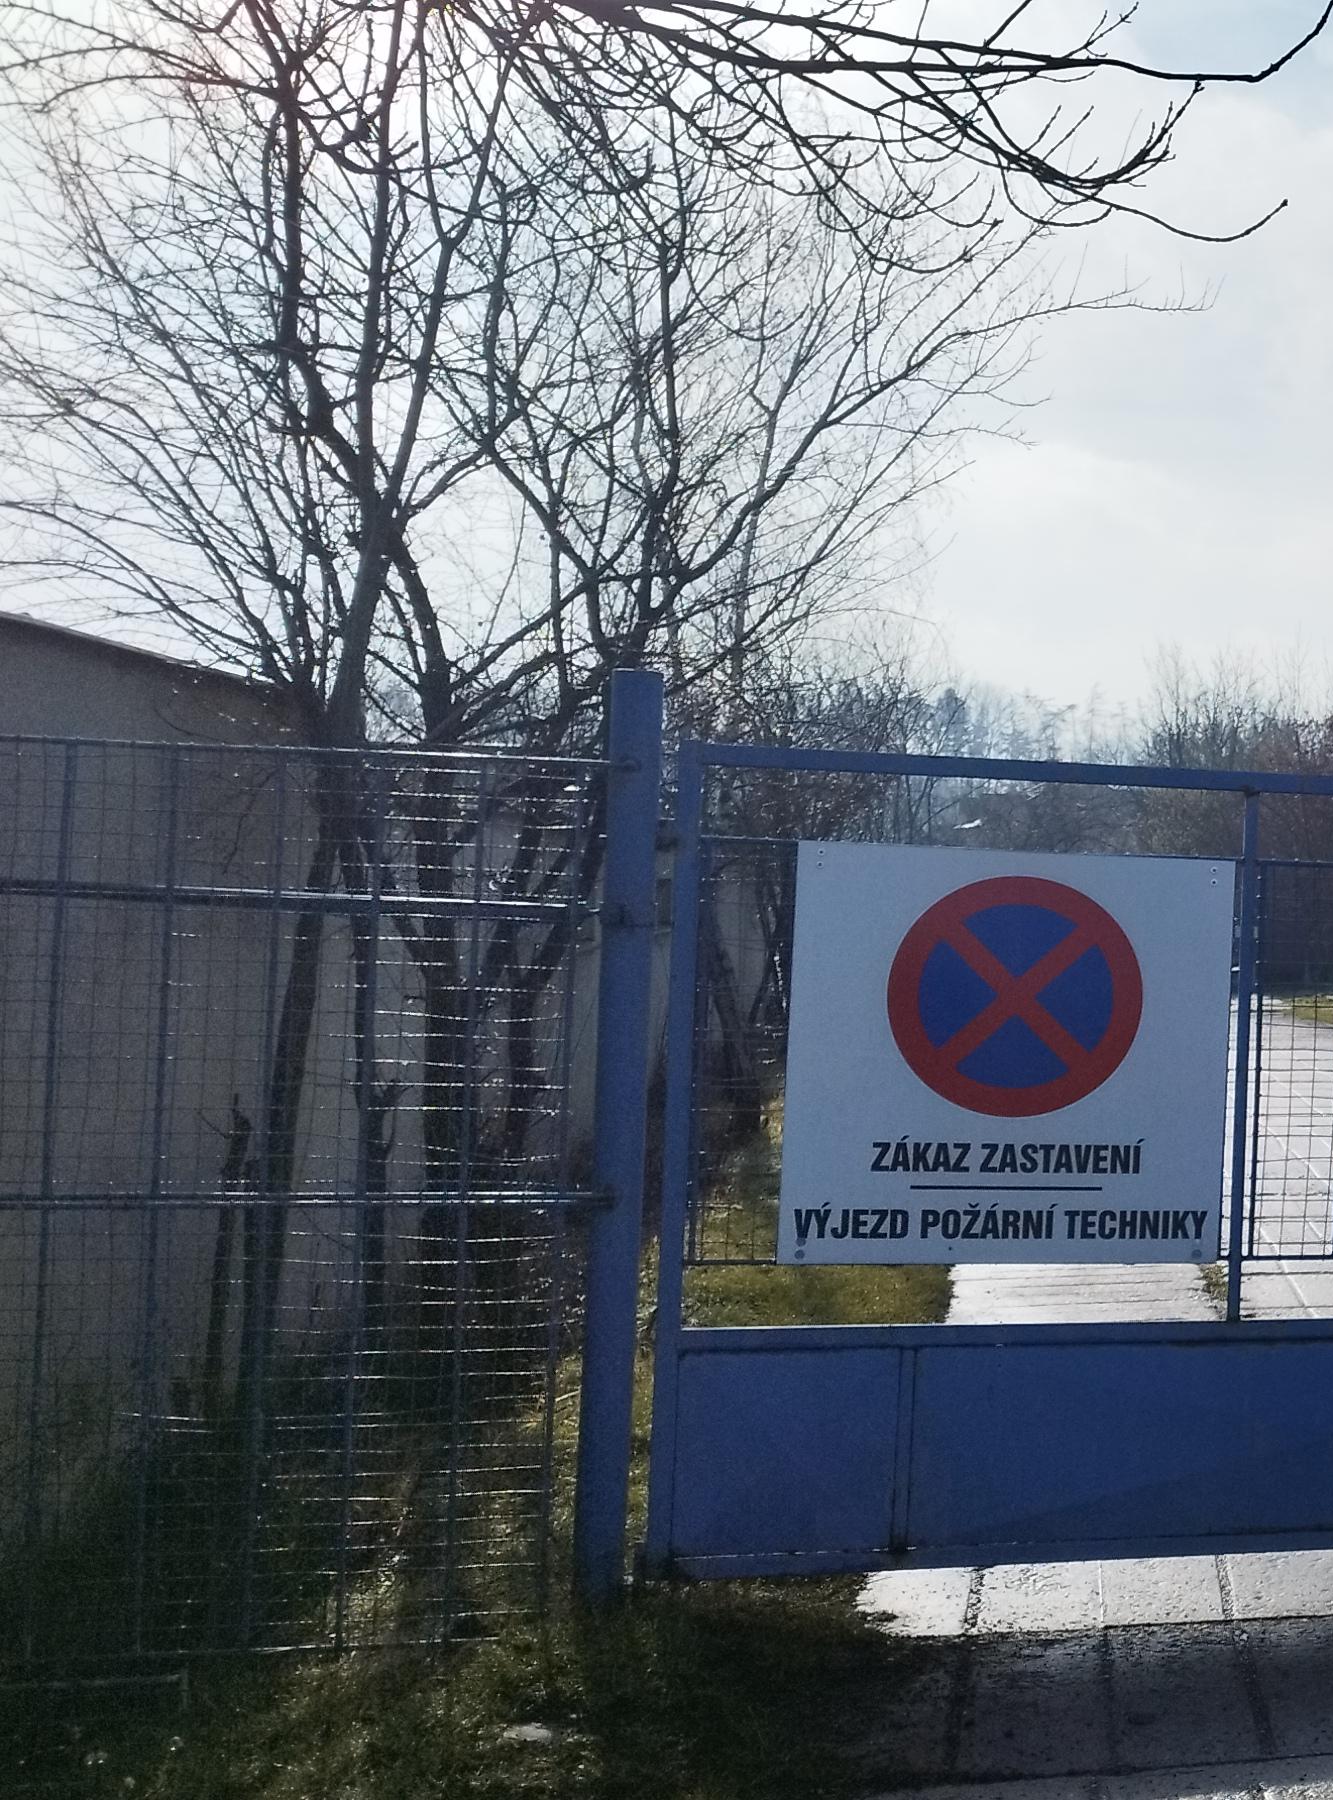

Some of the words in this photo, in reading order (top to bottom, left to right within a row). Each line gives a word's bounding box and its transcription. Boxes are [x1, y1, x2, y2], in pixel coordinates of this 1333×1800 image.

[870, 1135, 971, 1173] ZÁKAZ
[980, 1138, 1146, 1174] ZASTAVENÍ
[794, 1202, 909, 1240] VÝJEZD
[920, 1202, 1057, 1240] POŽÁRNÍ
[1064, 1208, 1208, 1241] TECHNIKY
